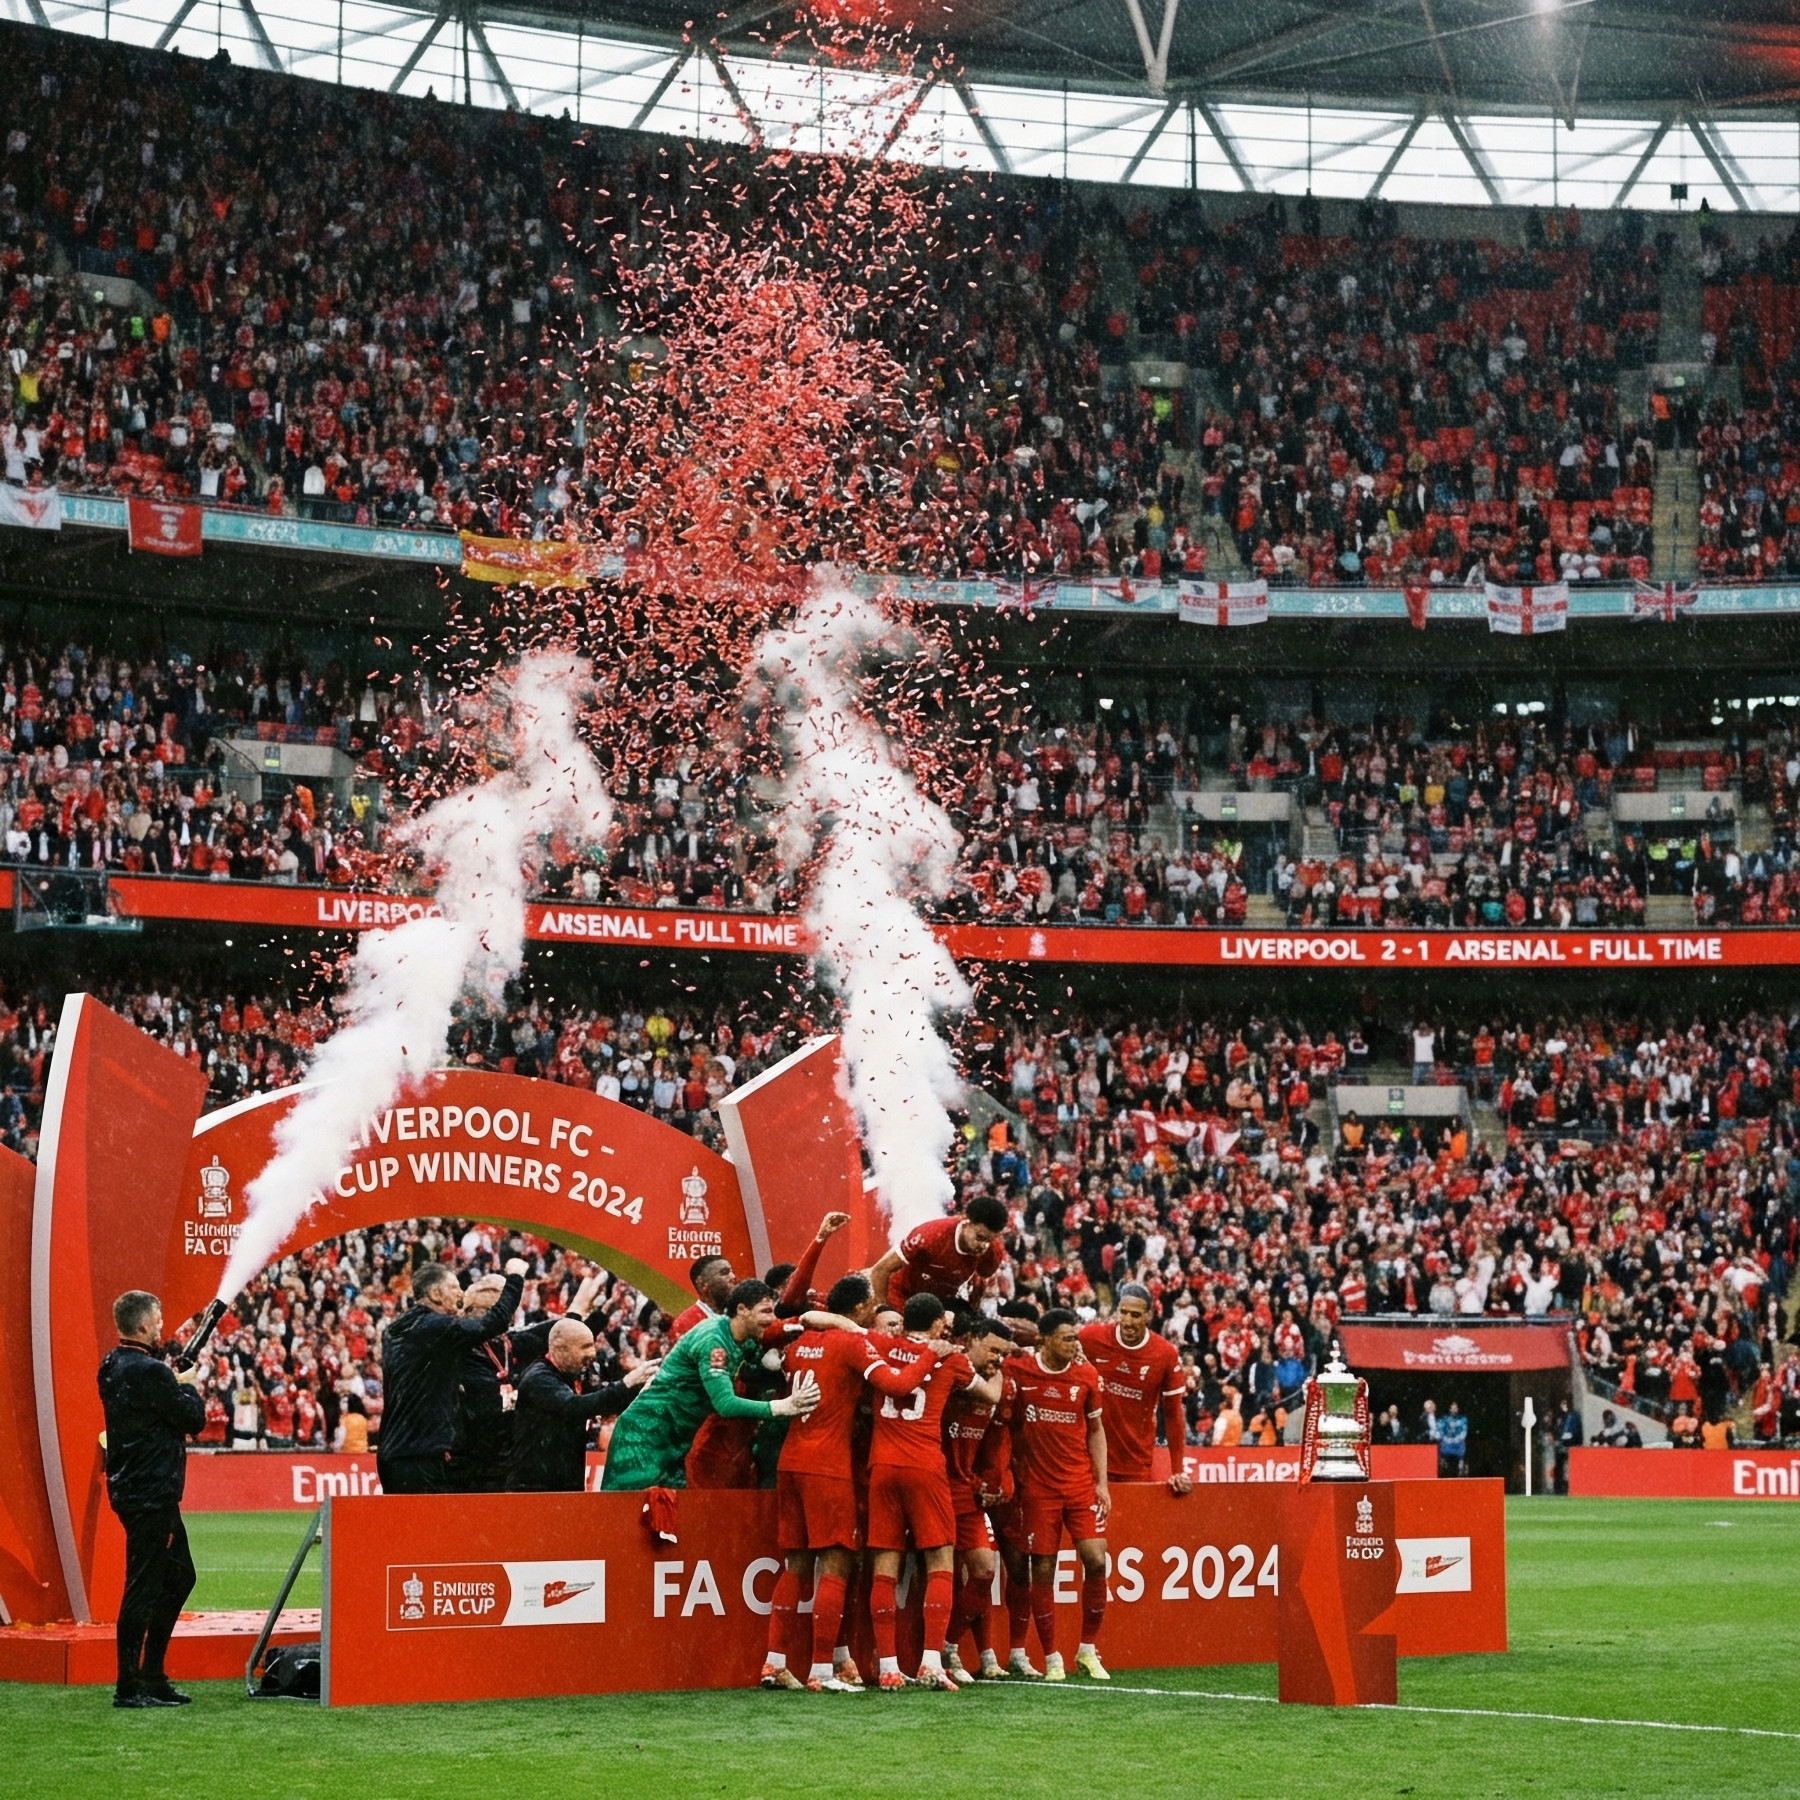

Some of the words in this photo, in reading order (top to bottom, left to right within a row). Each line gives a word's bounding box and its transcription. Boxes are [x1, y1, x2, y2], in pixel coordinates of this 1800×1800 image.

[318, 897, 443, 923] LIVERPOO
[539, 911, 652, 939] ARSENAL
[675, 919, 735, 943] FULL
[740, 922, 799, 946] TIME
[1221, 937, 1365, 960] LIVERPOOL
[1446, 939, 1566, 961] ARSENAL
[1590, 939, 1653, 960] FULL
[1659, 938, 1722, 959] TIME
[349, 1106, 540, 1150] IVERPOOL
[550, 1118, 593, 1157] FC
[335, 1157, 399, 1198] CUP
[407, 1152, 561, 1194] WINNERS
[568, 1171, 643, 1224] 2024
[185, 1237, 207, 1255] FA
[653, 1559, 726, 1617] FA
[1161, 1544, 1279, 1600] 2024
[433, 1600, 455, 1615] FA
[458, 1597, 496, 1615] CUP
